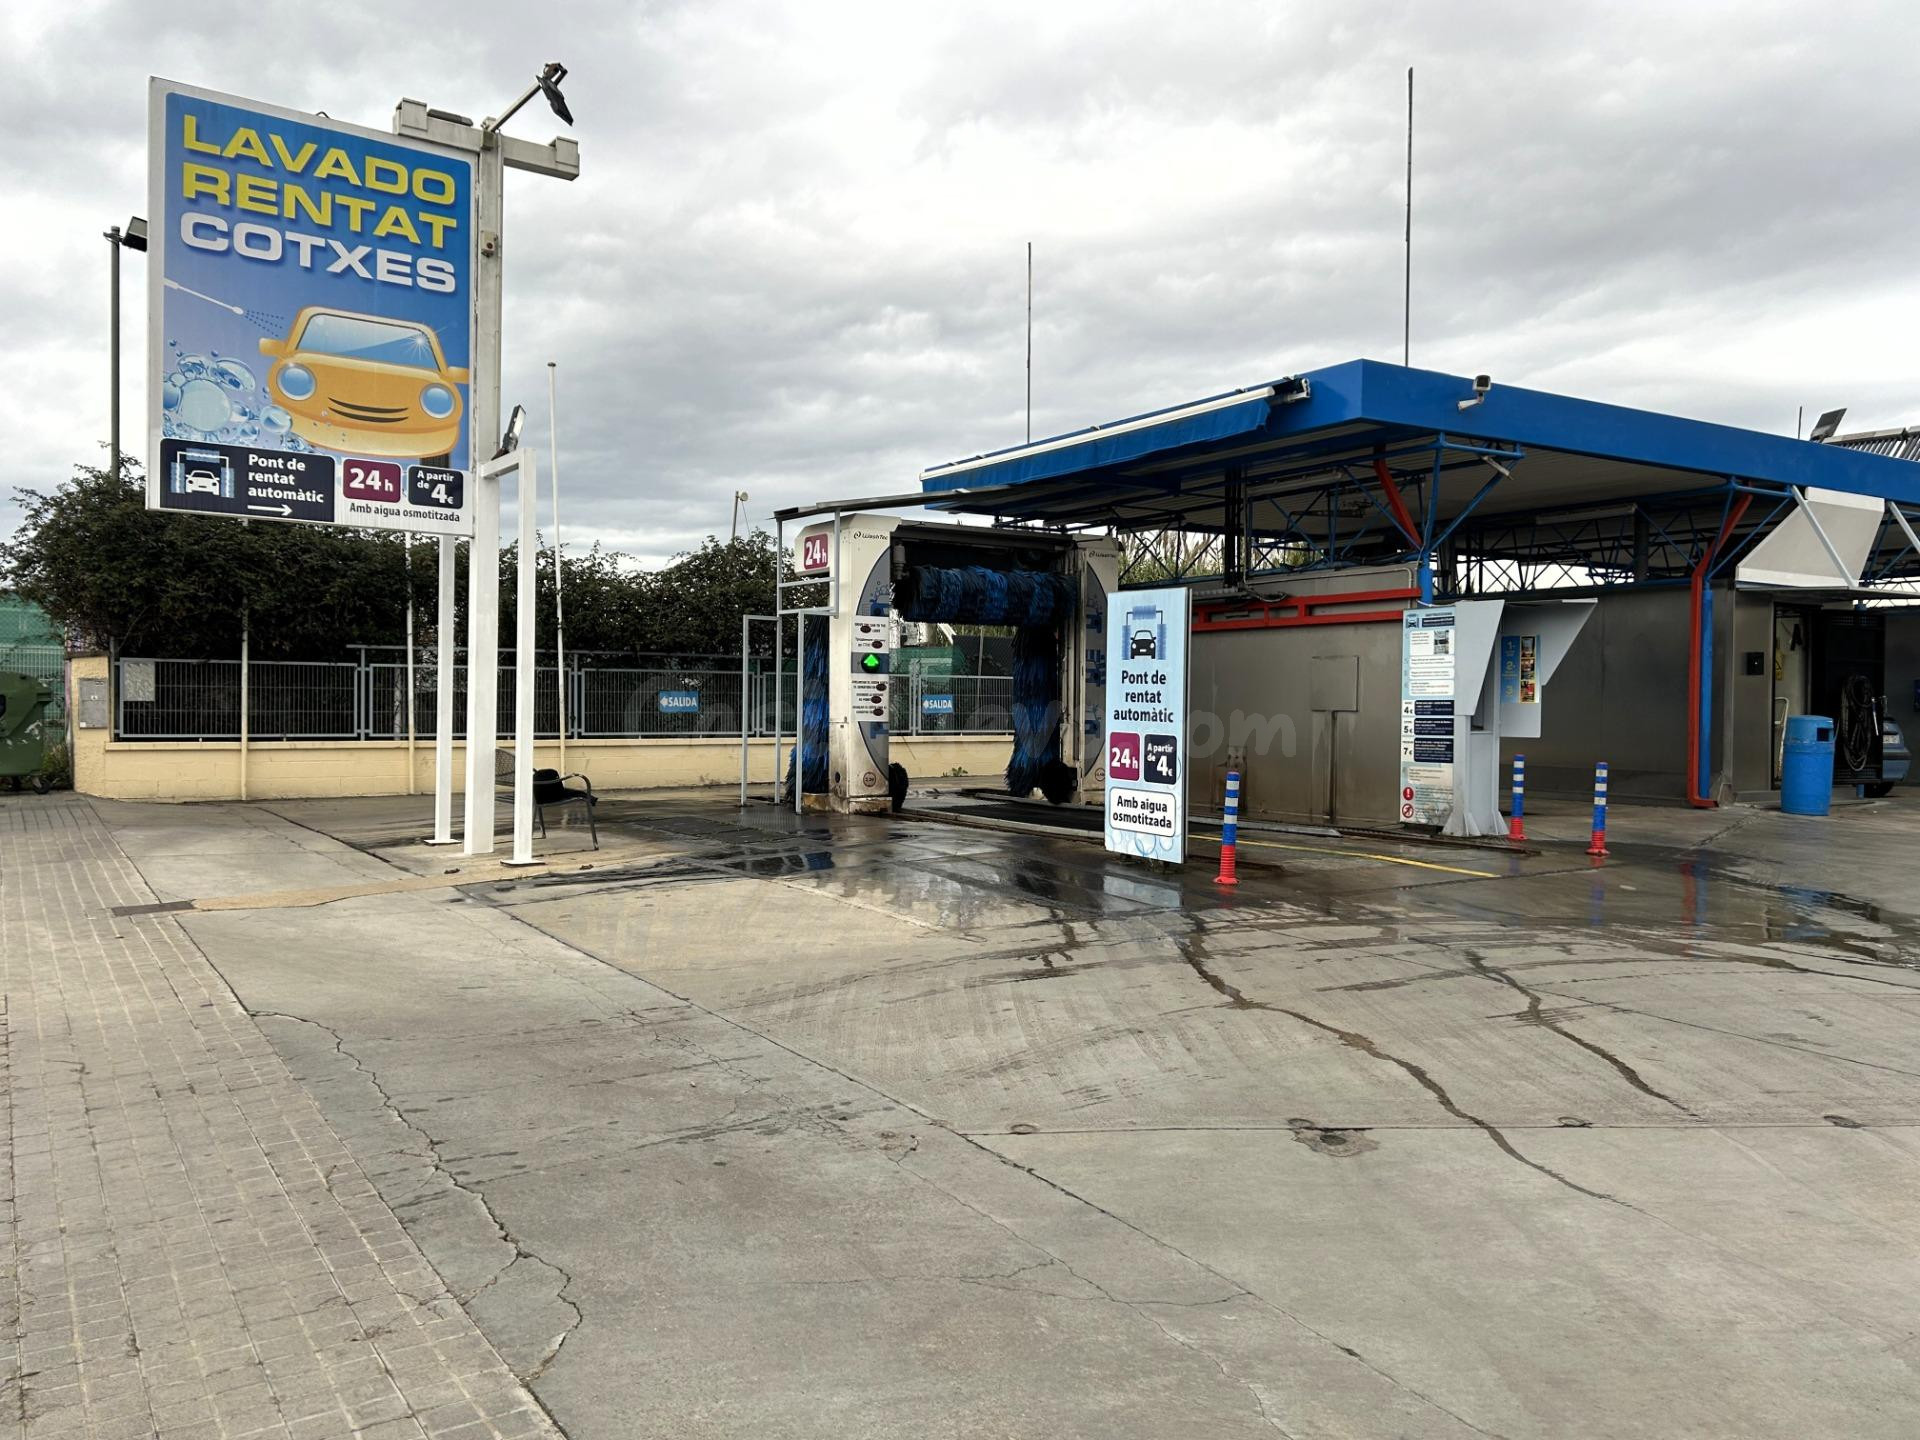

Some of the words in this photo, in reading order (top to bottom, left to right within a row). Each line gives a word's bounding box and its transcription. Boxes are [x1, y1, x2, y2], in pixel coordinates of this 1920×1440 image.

[183, 114, 456, 205] LAVADO
[182, 162, 457, 248] RENTAT
[180, 212, 456, 293] COTXES
[248, 454, 284, 470] Pont
[288, 459, 306, 472] de
[248, 471, 295, 486] rentat
[417, 470, 426, 480] A
[427, 471, 454, 483] partir
[417, 480, 430, 490] de
[248, 485, 324, 504] automàtic
[350, 502, 372, 514] Amb
[374, 505, 401, 518] aigua
[402, 509, 460, 523] osmotitzada
[1121, 670, 1148, 685] Pont
[1151, 670, 1167, 685] de
[667, 696, 698, 707] SALIDA
[928, 699, 953, 710] SALIDA
[1125, 690, 1162, 704] rentat
[1113, 707, 1174, 723] automàtic
[1147, 743, 1154, 751] A
[1153, 744, 1174, 753] partir
[1147, 753, 1156, 762] de
[1117, 795, 1139, 809] Amb
[1140, 798, 1168, 814] aigua
[1112, 812, 1172, 829] osmotitzada
